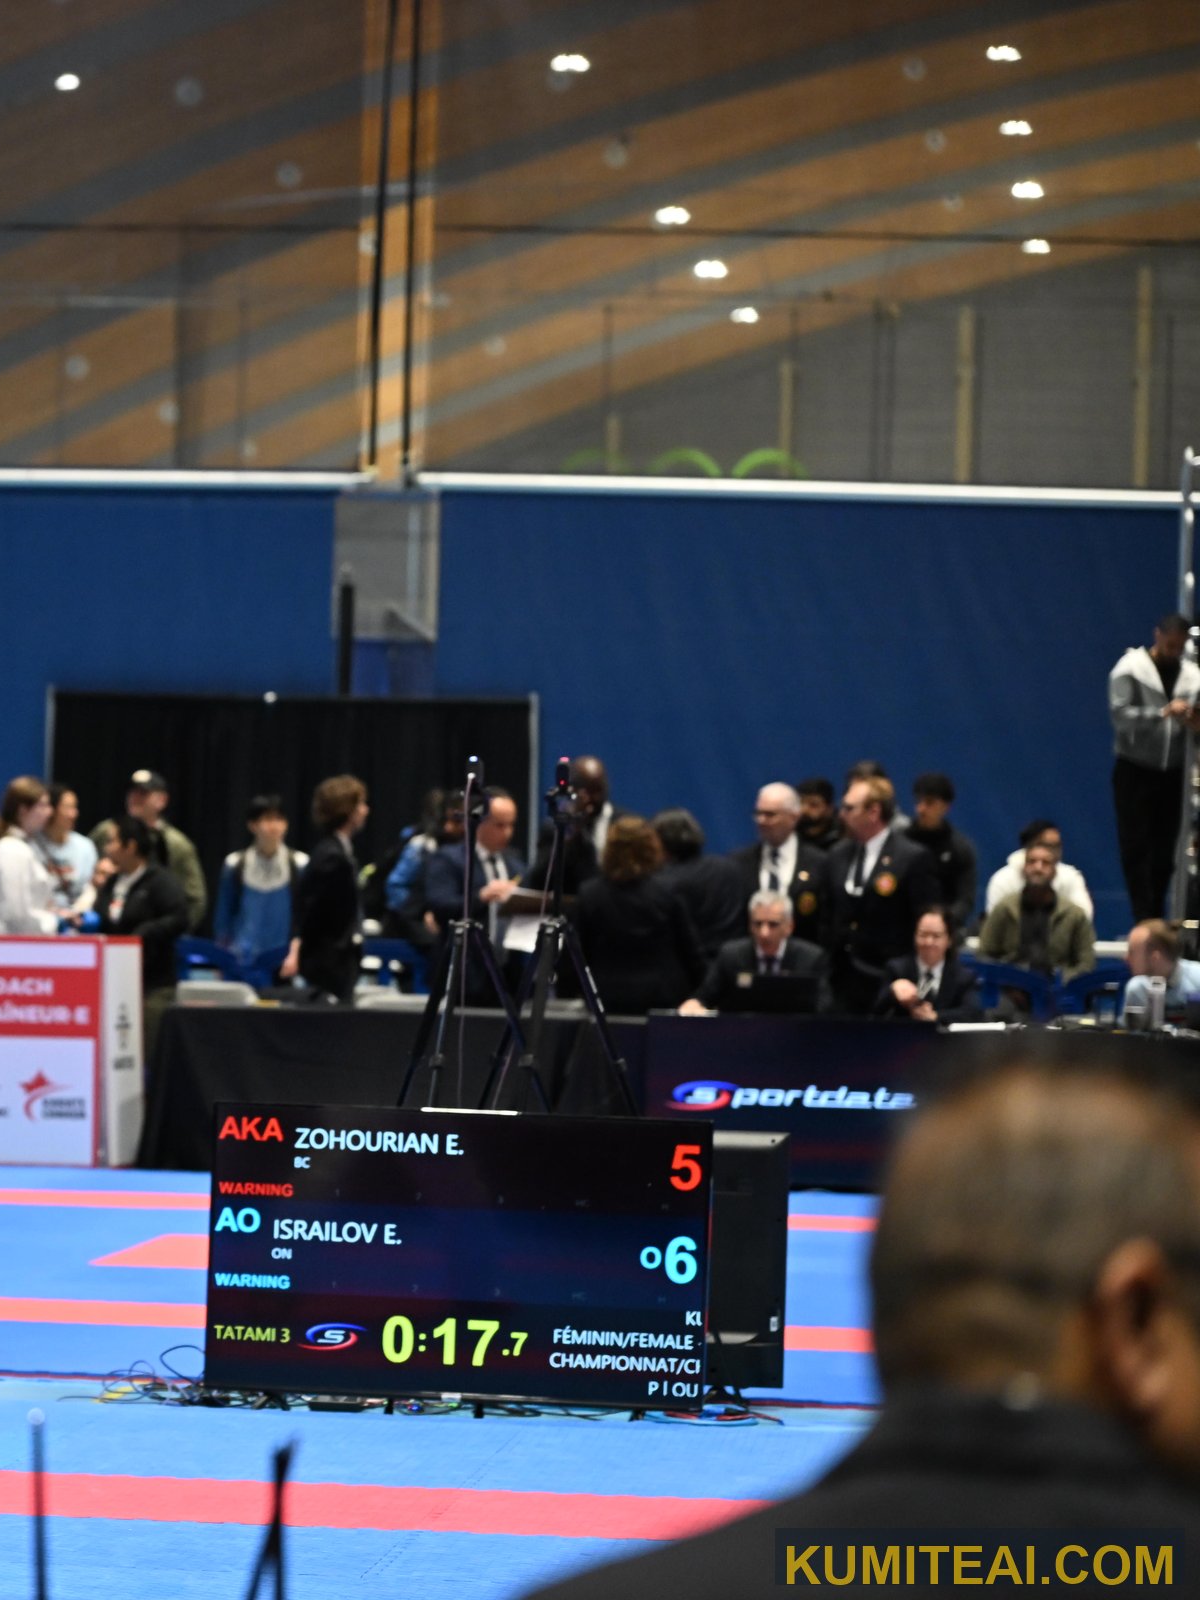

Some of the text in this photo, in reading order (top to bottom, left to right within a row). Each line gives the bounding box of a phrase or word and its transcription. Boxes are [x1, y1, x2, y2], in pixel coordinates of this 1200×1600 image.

[219, 1116, 284, 1142] AKA
[294, 1127, 465, 1155] ZOHOURIAN E.
[293, 1157, 311, 1169] BC
[669, 1144, 703, 1191] 5
[219, 1181, 294, 1197] WARNING
[214, 1207, 261, 1232] AO
[273, 1219, 402, 1245] ISRAILOV E.
[271, 1247, 292, 1260] ON
[214, 1272, 291, 1290] WARNING
[213, 1324, 291, 1343] TATAMI 3
[553, 1326, 694, 1350] FÉMININ/FEMALE
